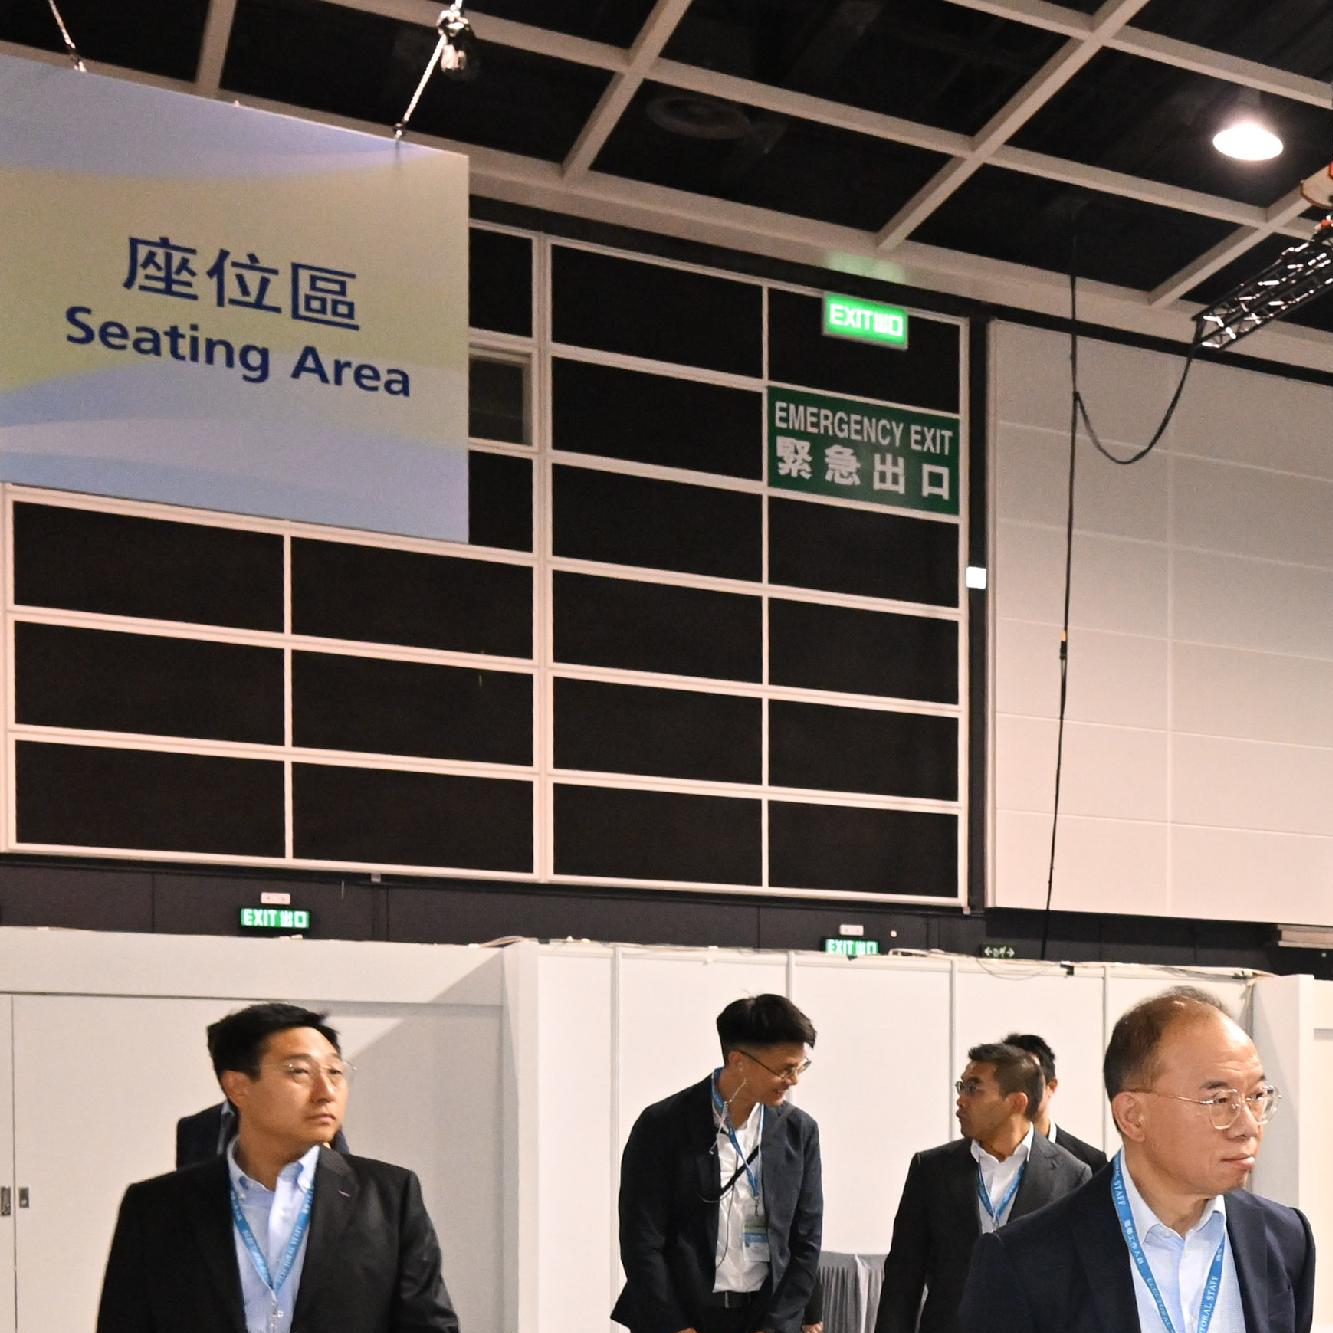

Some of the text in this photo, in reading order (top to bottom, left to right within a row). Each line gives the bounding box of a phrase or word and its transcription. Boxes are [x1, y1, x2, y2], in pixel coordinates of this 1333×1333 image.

[122, 236, 360, 331] 座位區
[829, 303, 873, 330] EXIT
[65, 305, 410, 398] Seating Area
[775, 401, 953, 455] EMERGENCY EXIT
[776, 435, 950, 501] 緊急出口
[242, 908, 277, 927] EXIT
[828, 939, 853, 955] EXIT
[1207, 1275, 1219, 1302] STAFF
